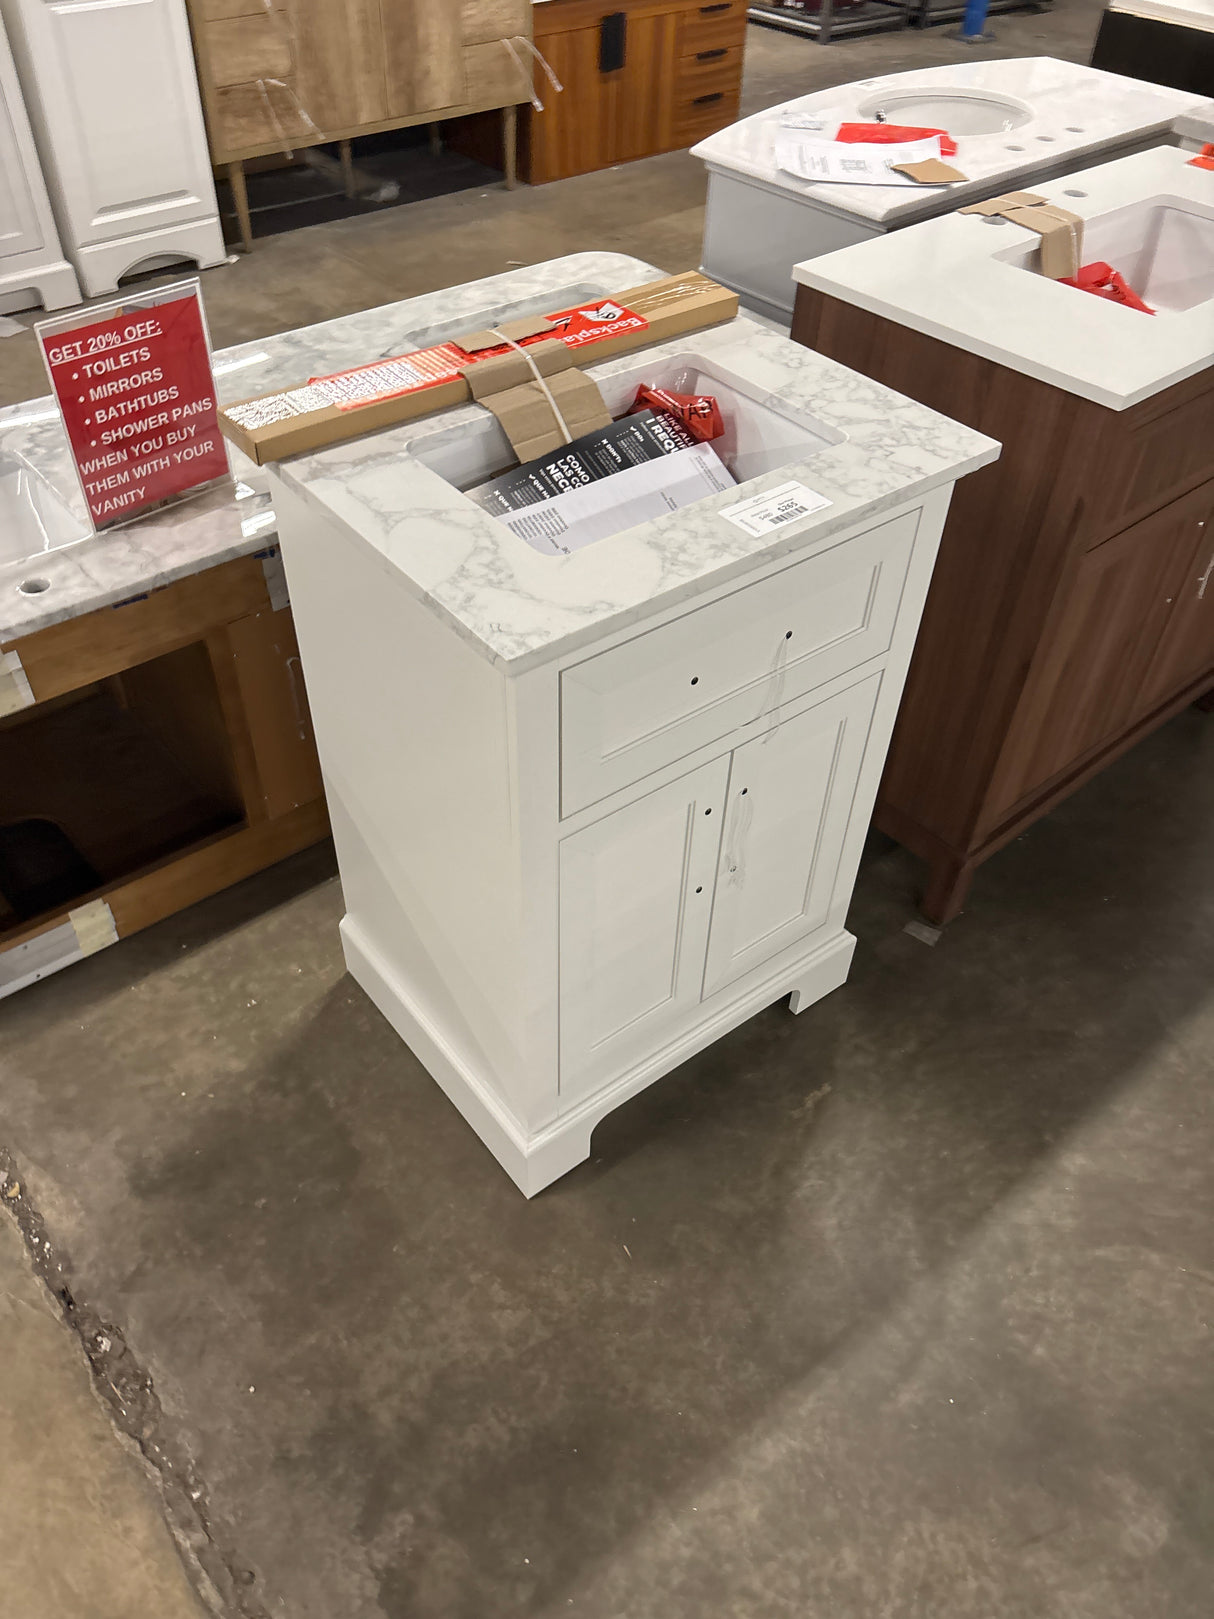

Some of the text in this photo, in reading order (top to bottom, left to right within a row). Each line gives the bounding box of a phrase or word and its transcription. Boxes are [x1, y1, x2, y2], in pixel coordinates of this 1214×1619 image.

[49, 319, 163, 363] GET 20% OFF:
[563, 317, 642, 343] Backspla
[82, 346, 151, 378] TOILETS
[89, 367, 163, 402] MIRRORS
[95, 386, 179, 424] BATHTUBS
[101, 412, 169, 447] SHOWER
[172, 397, 213, 422] PANS
[663, 412, 683, 432] LIKE
[79, 425, 197, 476] WHEN YOU BUY
[85, 440, 214, 496] THEM WITH YOUR
[556, 458, 574, 477] LAS
[566, 454, 590, 483] COMO
[91, 486, 147, 516] VANITY
